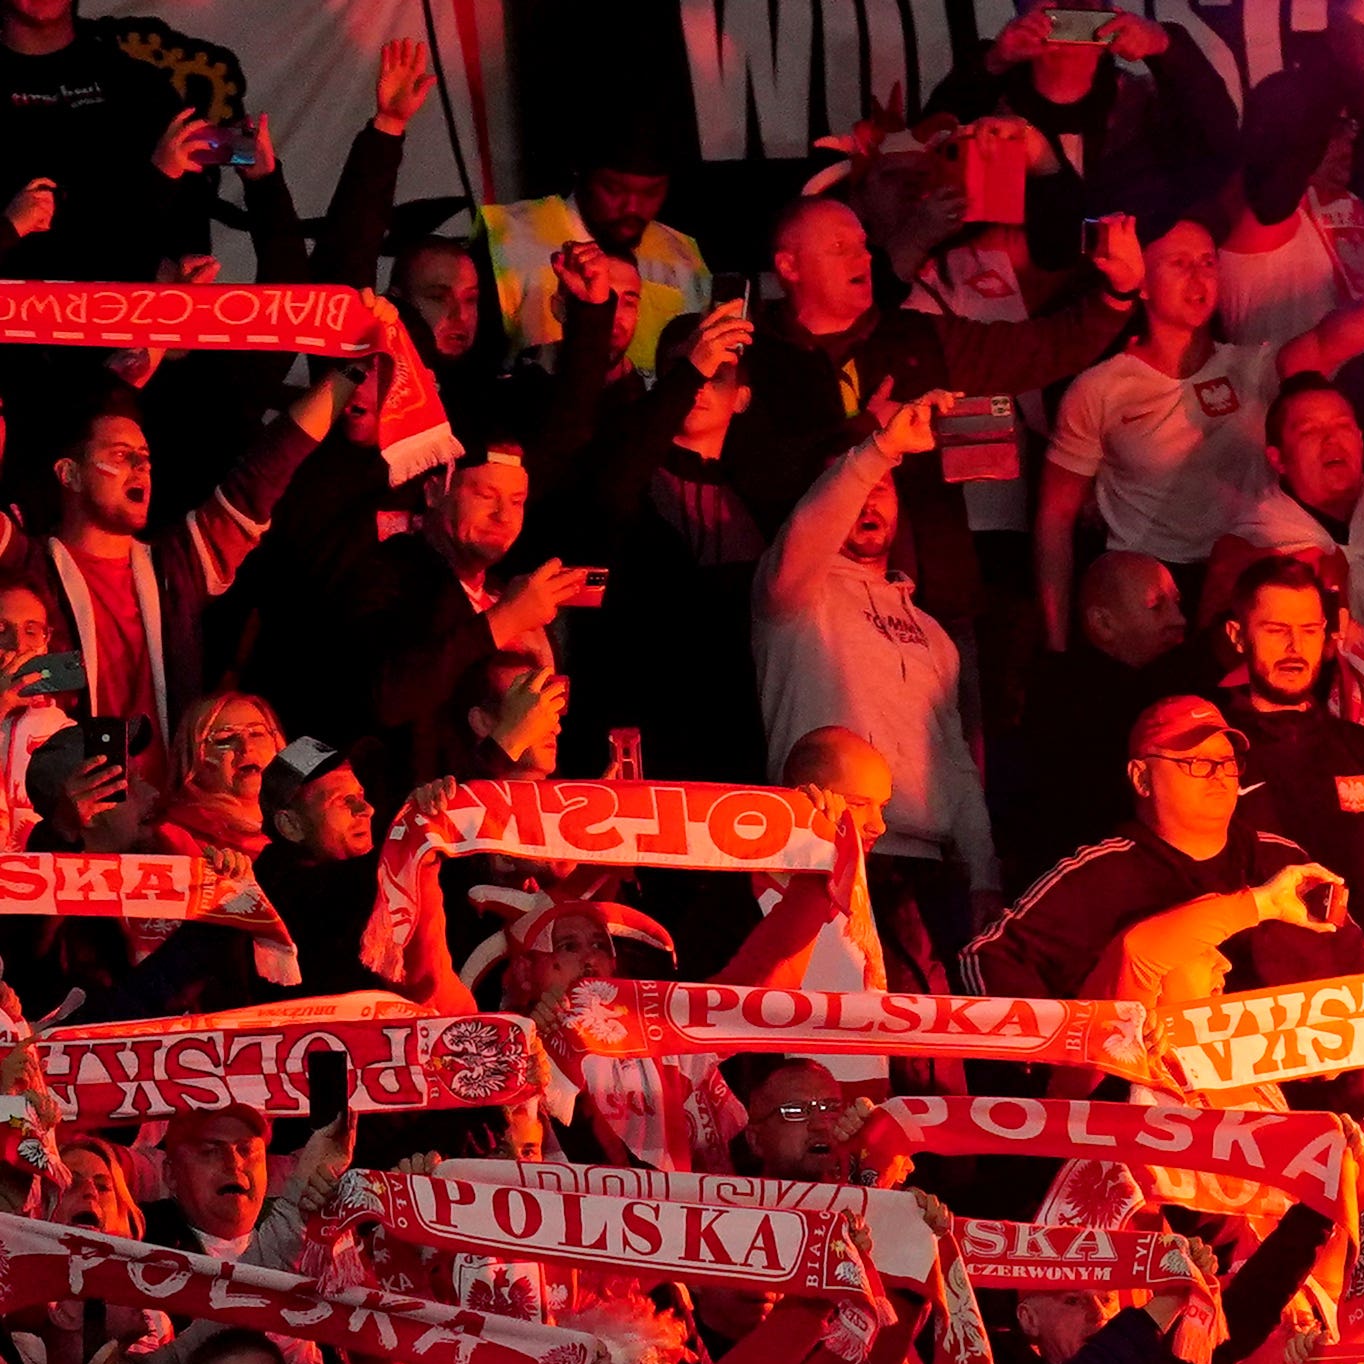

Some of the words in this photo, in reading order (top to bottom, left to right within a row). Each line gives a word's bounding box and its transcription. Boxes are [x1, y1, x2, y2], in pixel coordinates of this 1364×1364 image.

[680, 984, 1048, 1037] POLSKA
[882, 1097, 1348, 1200] POLSKA
[429, 1174, 786, 1271] POLSKA
[962, 1221, 1118, 1262] SKA
[965, 1262, 1113, 1282] CZERWONYM
